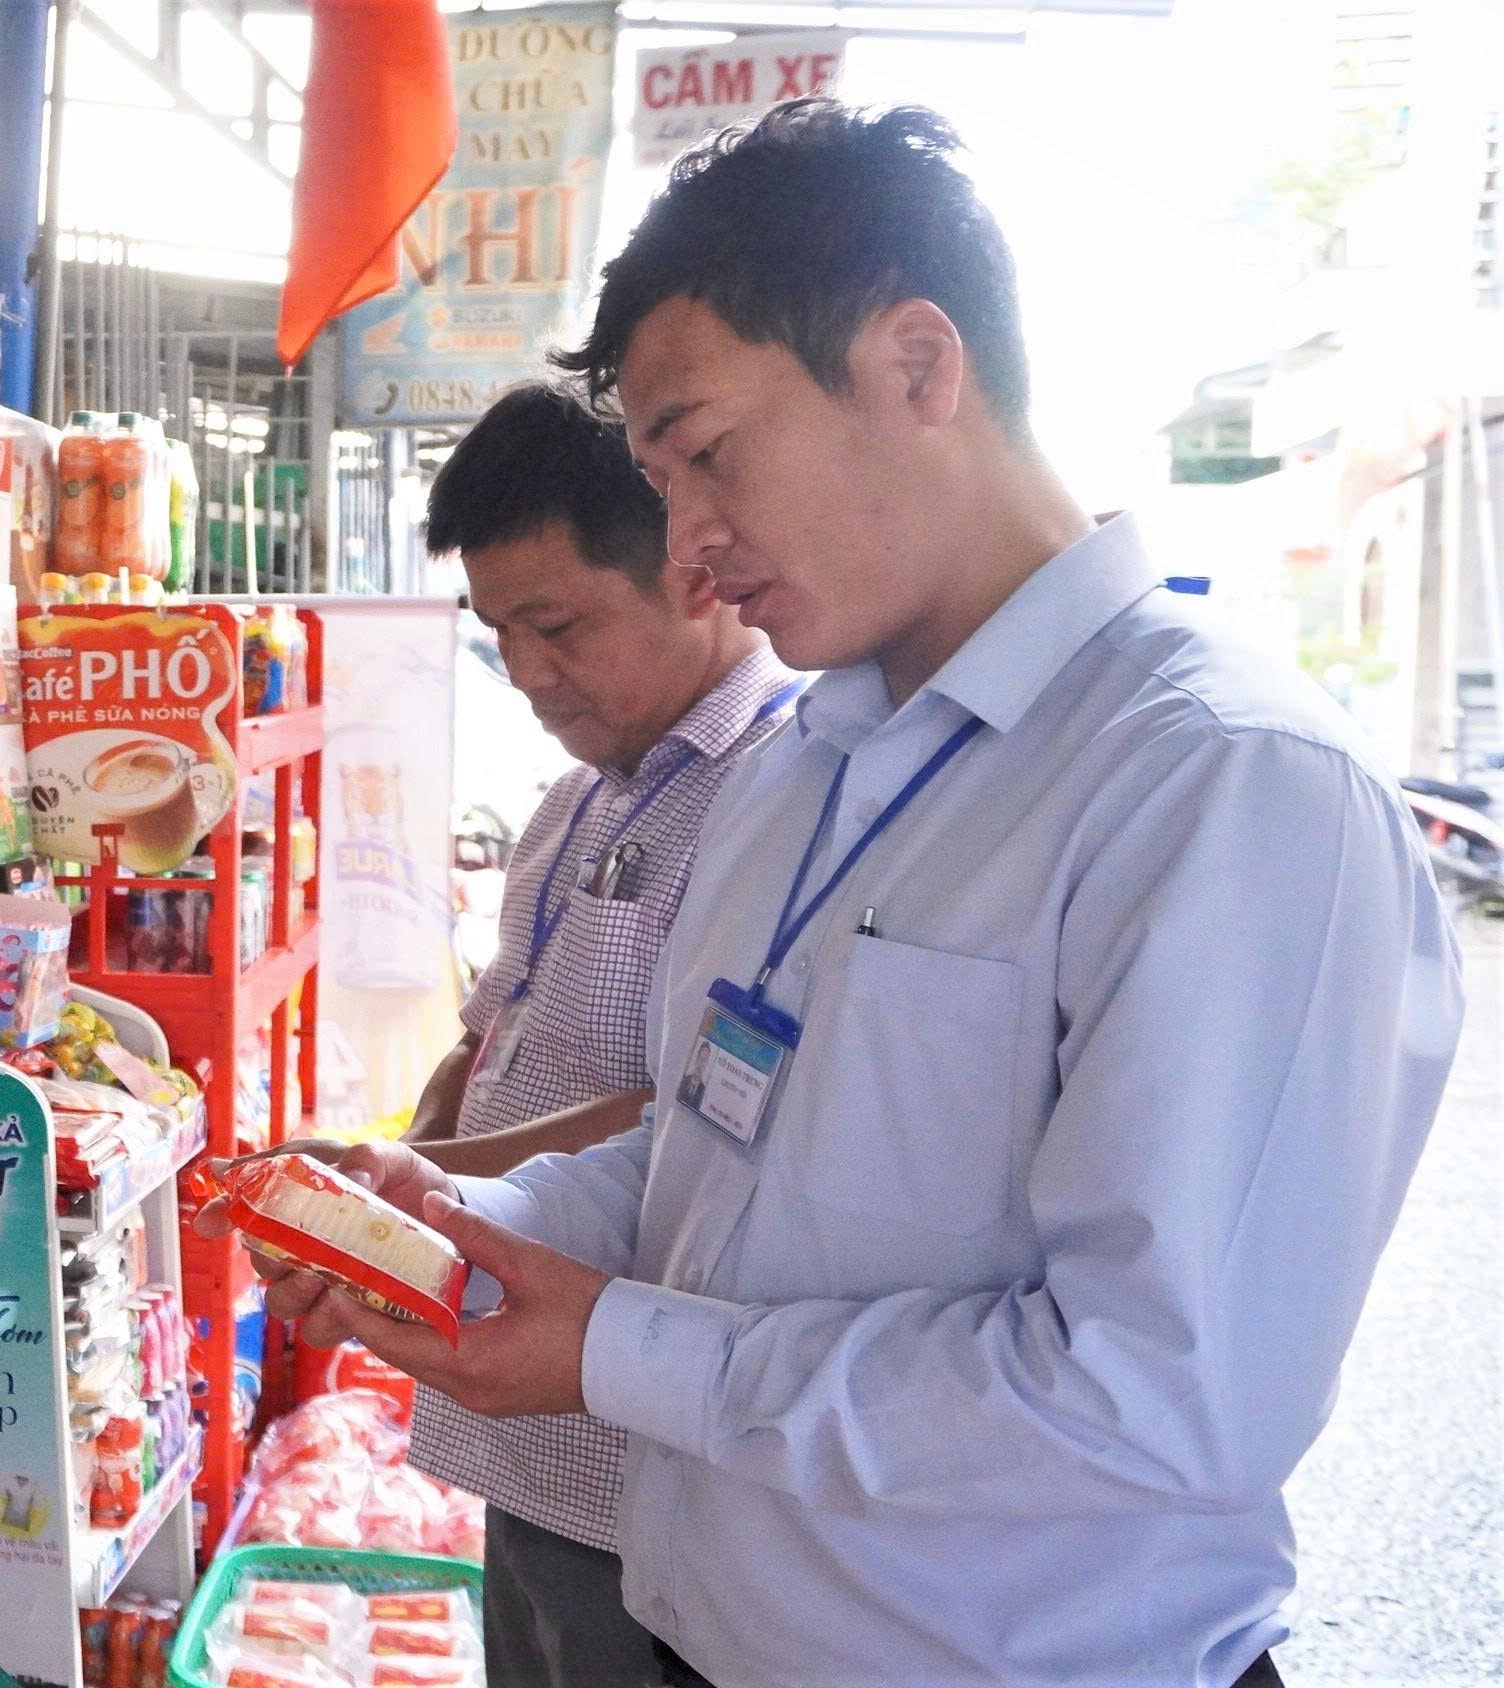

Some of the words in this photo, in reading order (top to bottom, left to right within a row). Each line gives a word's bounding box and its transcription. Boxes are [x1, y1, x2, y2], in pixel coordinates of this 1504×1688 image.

[25, 665, 74, 701] afé
[79, 628, 212, 700] PHỐ
[47, 705, 88, 723] PHÊ
[94, 705, 133, 722] SỮA
[141, 705, 201, 721] NÓNG
